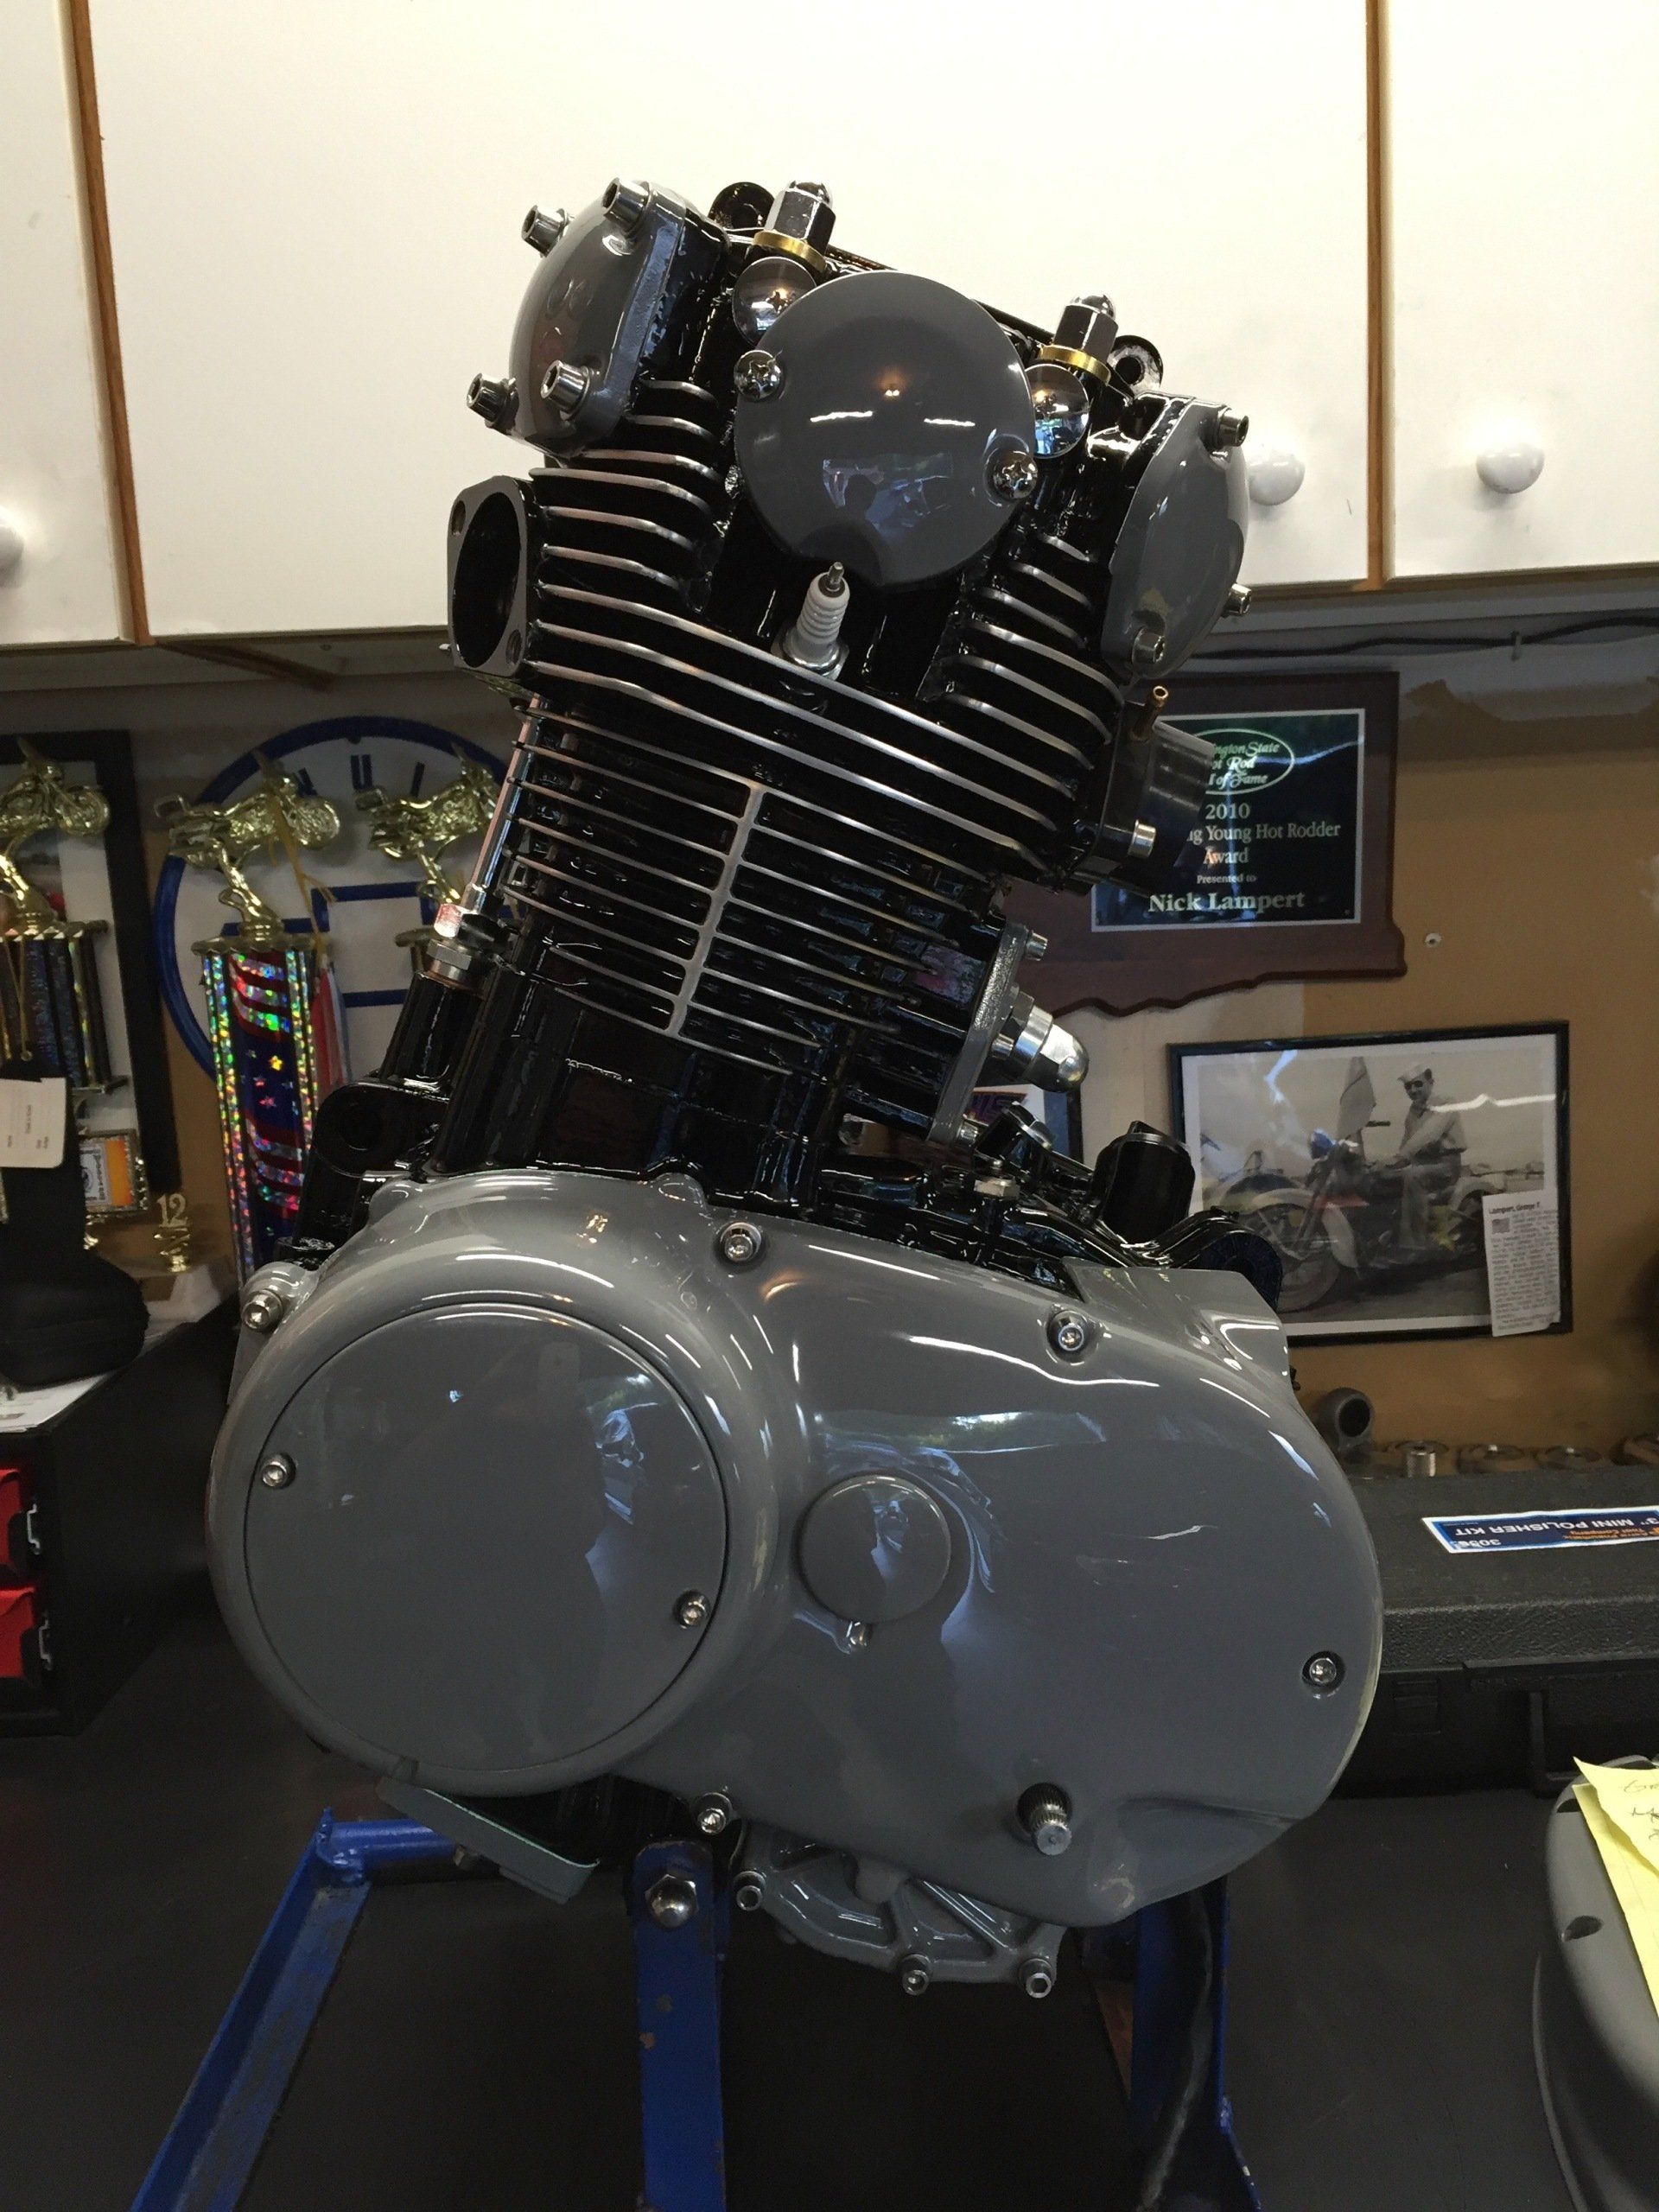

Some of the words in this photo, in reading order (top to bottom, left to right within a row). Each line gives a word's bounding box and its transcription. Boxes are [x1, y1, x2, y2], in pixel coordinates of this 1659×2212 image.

[1245, 741, 1280, 757] State
[1227, 756, 1257, 775] Rod
[1216, 771, 1232, 790] of
[1230, 773, 1268, 788] Fame
[1205, 803, 1250, 820] 2010
[1205, 825, 1252, 844] Young
[1255, 823, 1284, 839] Hot
[1287, 820, 1341, 838] Rodder
[1203, 846, 1249, 864] Award
[1197, 874, 1243, 884] Presented
[1246, 874, 1256, 883] to
[1148, 892, 1202, 912] Nick
[1208, 892, 1306, 913] Lampert
[157, 1193, 188, 1227] 12
[1455, 1527, 1484, 1536] KIT
[1489, 1520, 1588, 1535] POLISHER
[1591, 1518, 1634, 1528] MINI
